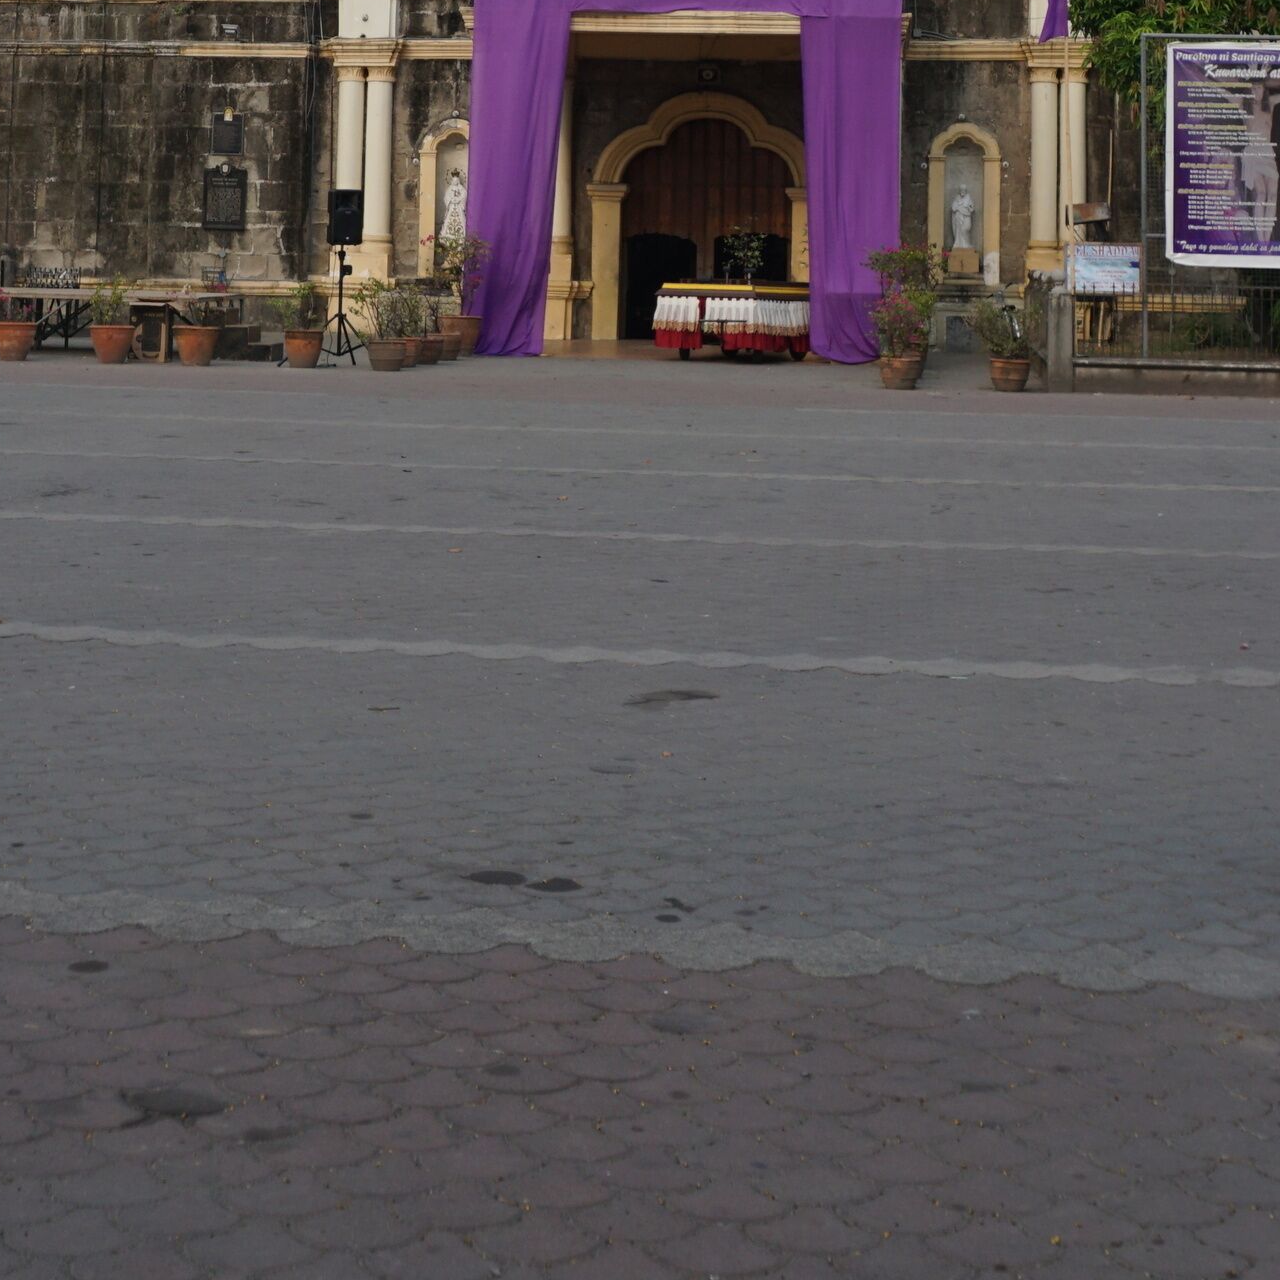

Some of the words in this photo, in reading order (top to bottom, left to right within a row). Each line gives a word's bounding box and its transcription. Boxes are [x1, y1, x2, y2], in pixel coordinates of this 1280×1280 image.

[1176, 52, 1217, 63] Parokya
[1219, 53, 1230, 61] ni
[1231, 52, 1276, 62] Santiago
[1204, 64, 1267, 79] Kuwaresma
